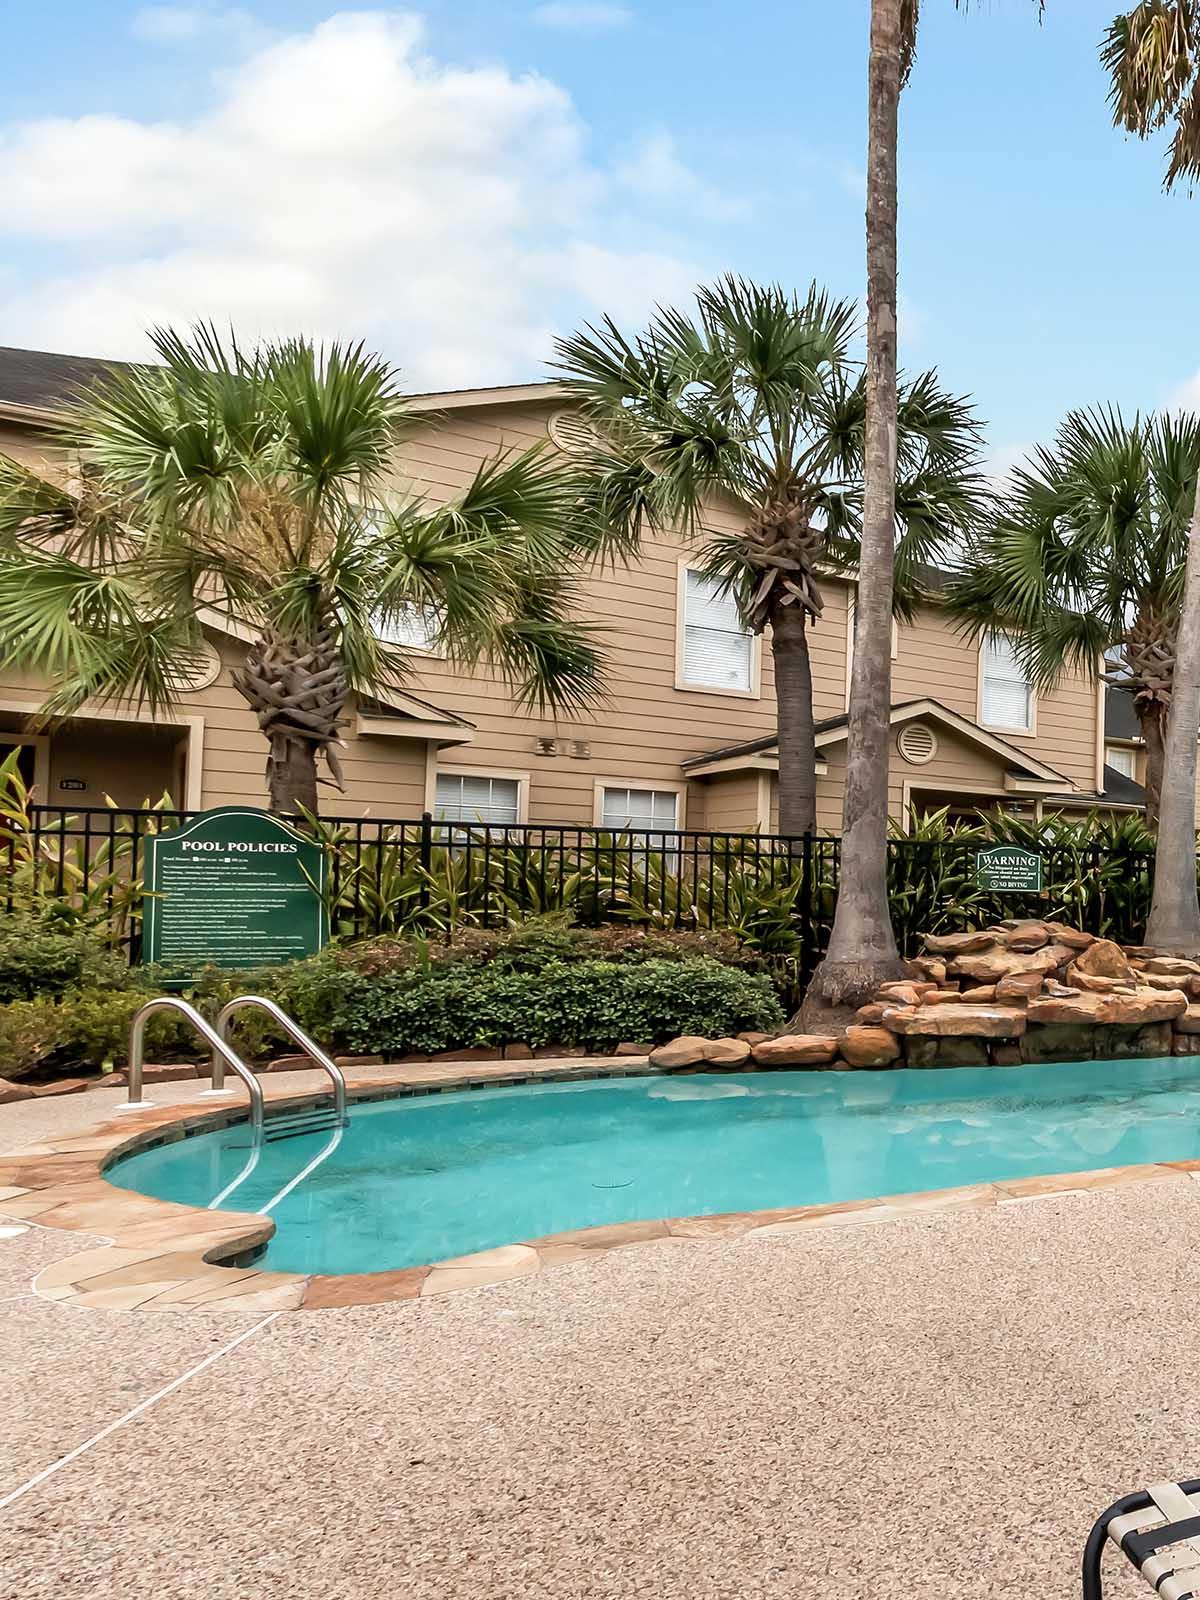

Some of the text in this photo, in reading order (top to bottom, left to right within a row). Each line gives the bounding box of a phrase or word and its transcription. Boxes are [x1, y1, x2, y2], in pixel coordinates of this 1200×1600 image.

[182, 841, 298, 853] POOL POLICIES
[982, 855, 1036, 866] WARNING
